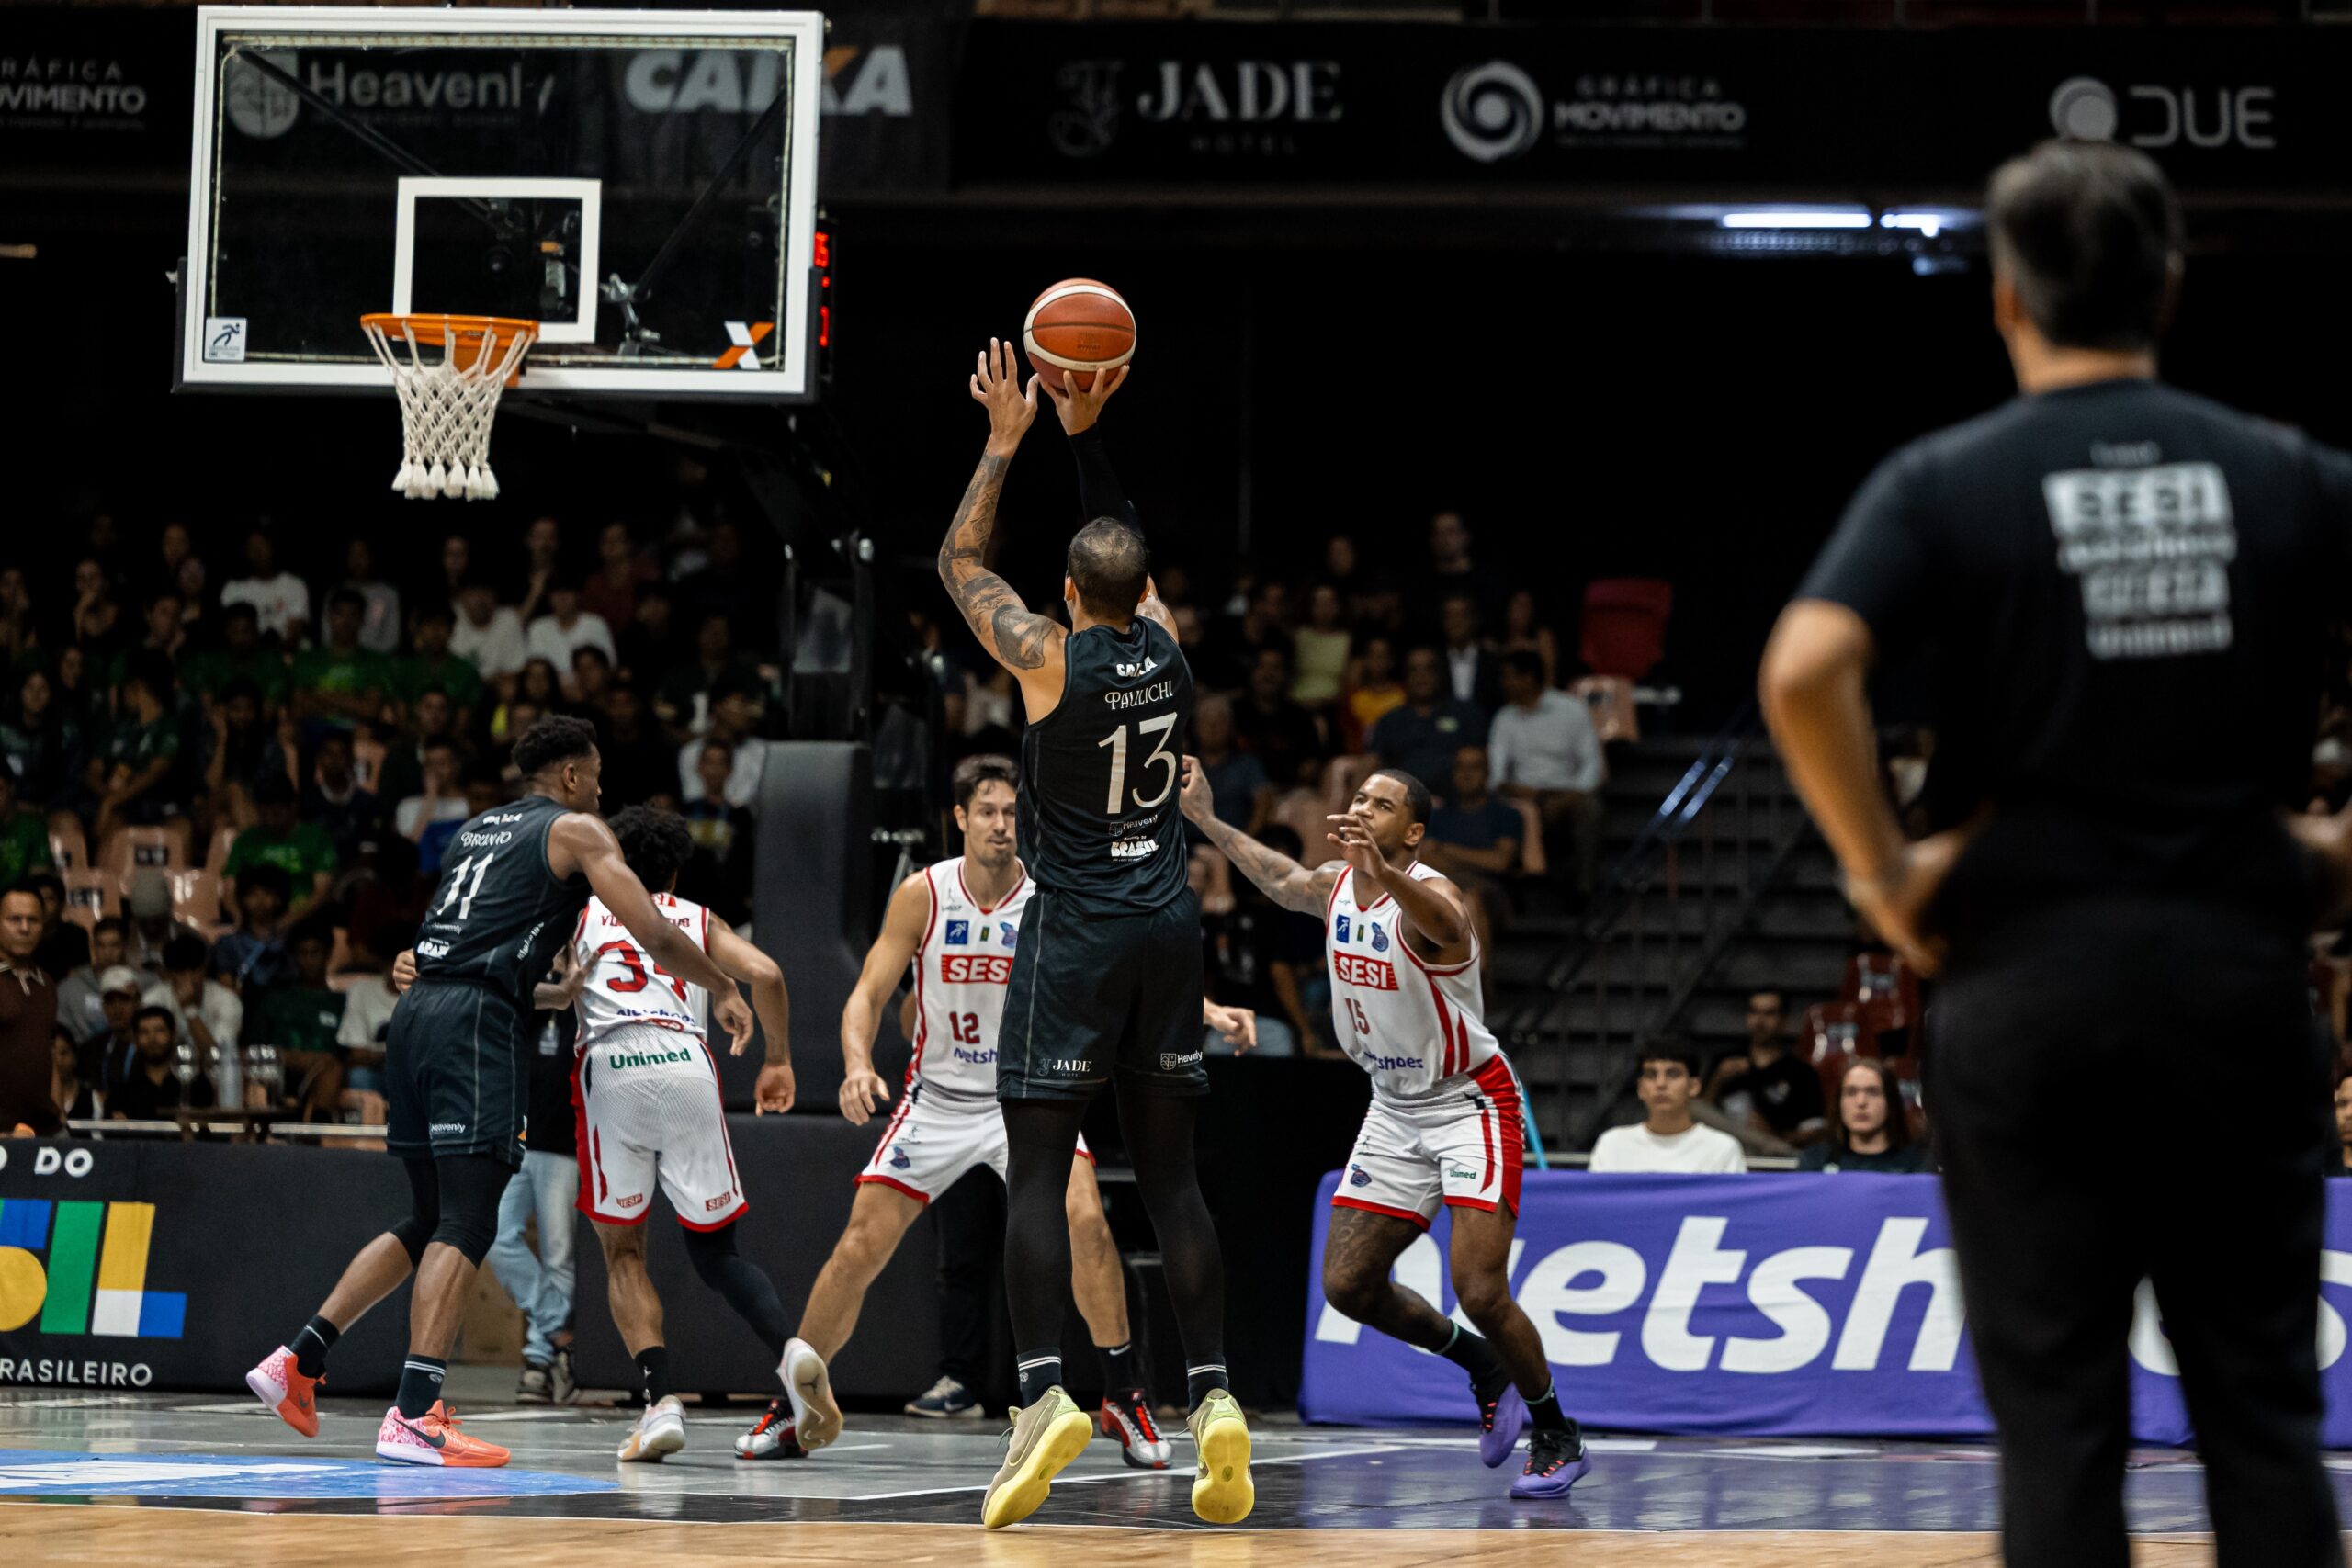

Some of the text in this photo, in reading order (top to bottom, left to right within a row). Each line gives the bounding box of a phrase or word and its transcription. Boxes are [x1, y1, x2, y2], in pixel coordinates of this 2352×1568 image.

[0, 83, 147, 114] VIMENTO
[1136, 60, 1342, 121] JADE
[1104, 680, 1173, 710] PAULICHI
[1098, 711, 1178, 814] 13
[436, 852, 494, 919] 11
[947, 957, 1013, 982] SES
[1338, 956, 1388, 989] SESI
[949, 1011, 980, 1044] 12
[1344, 998, 1370, 1035] 15
[609, 1047, 692, 1069] Unimed
[1052, 1059, 1091, 1072] JADE
